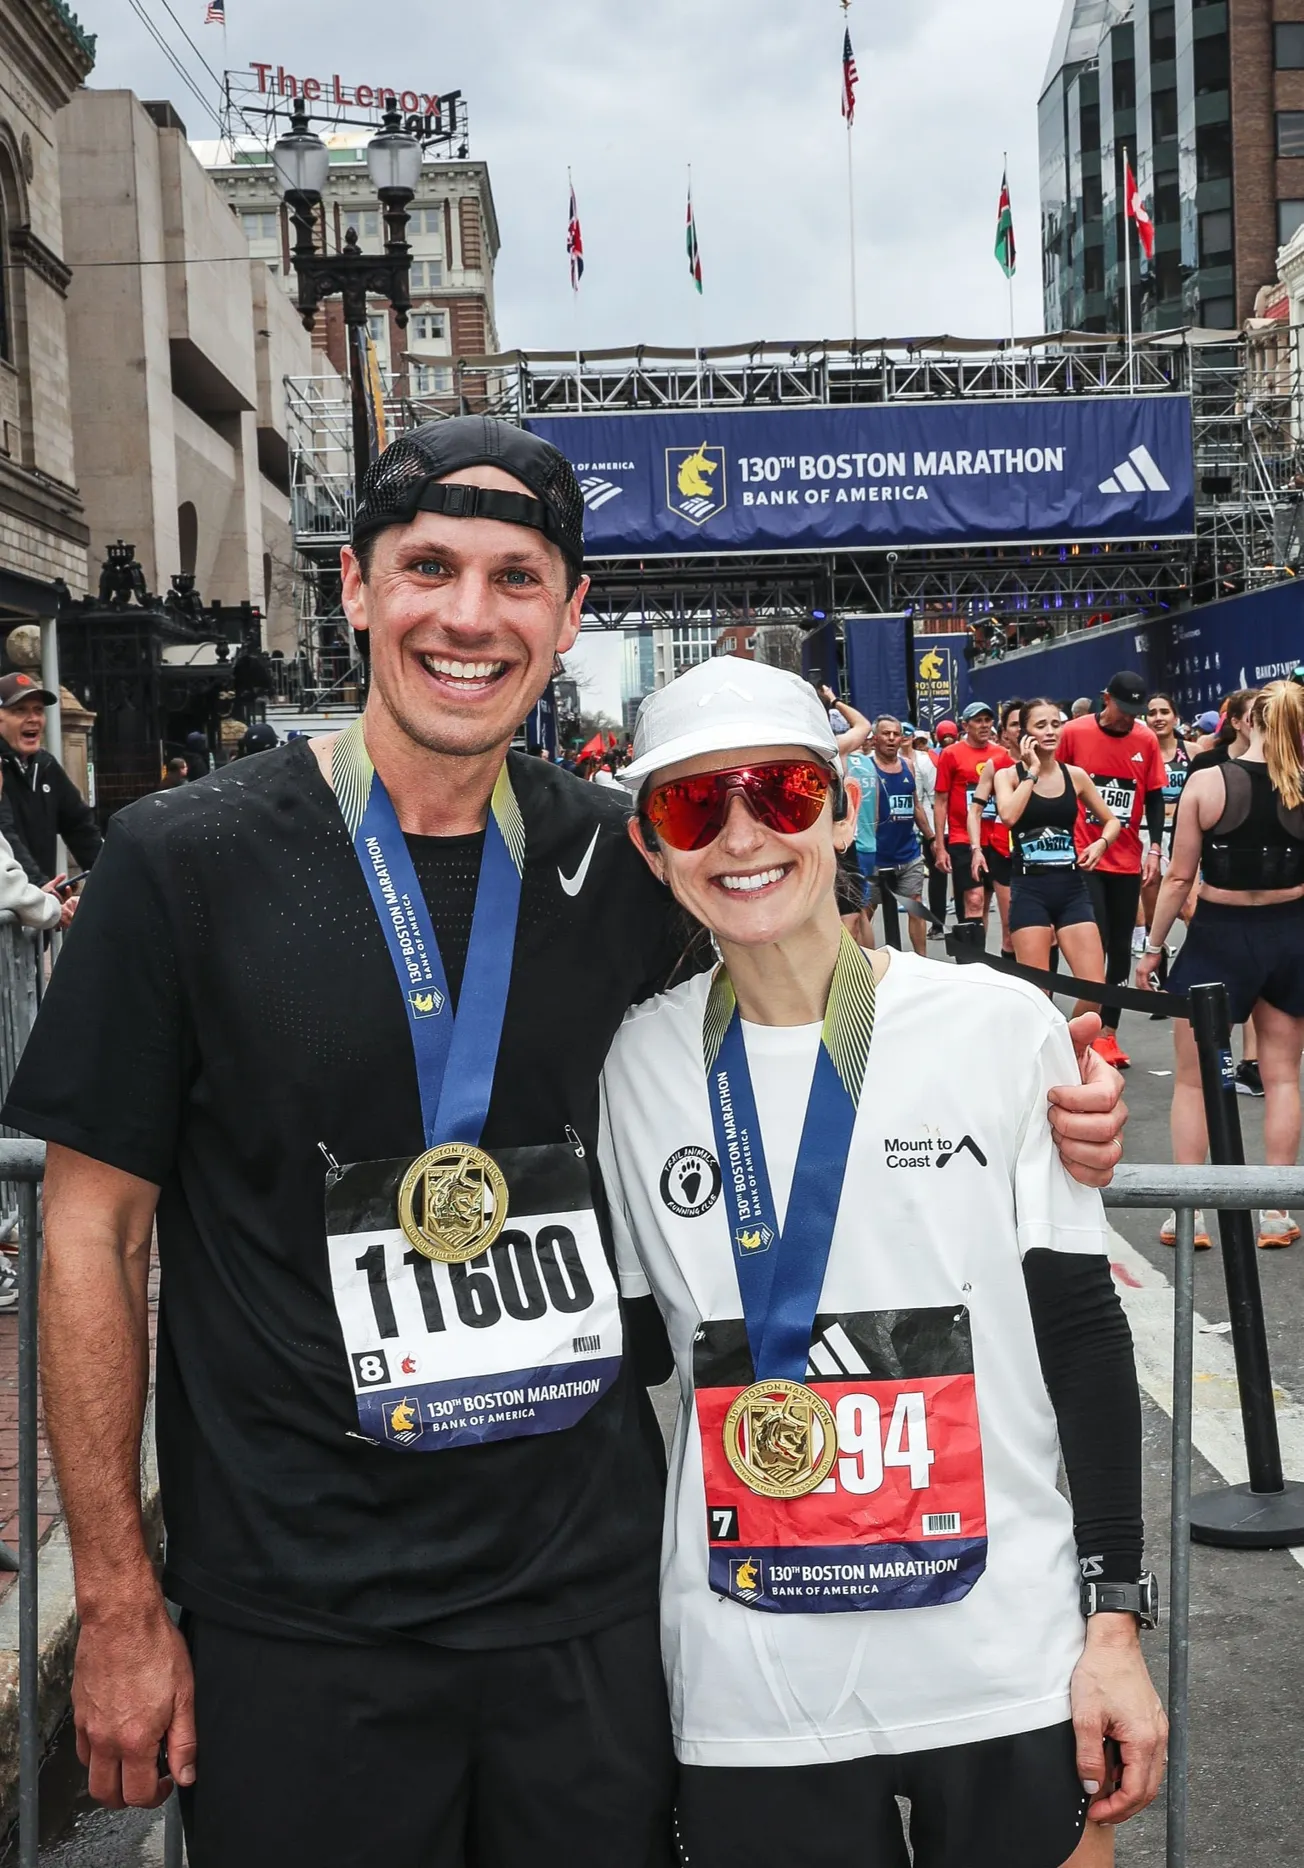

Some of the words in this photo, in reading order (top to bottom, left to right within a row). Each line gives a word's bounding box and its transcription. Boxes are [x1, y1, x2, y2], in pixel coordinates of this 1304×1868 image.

[249, 62, 321, 101] The
[332, 74, 440, 116] Lenox
[577, 463, 590, 471] OF
[591, 462, 635, 471] AMERICA
[738, 457, 795, 482] 130TH
[799, 452, 906, 480] BOSTON
[914, 447, 1063, 476] MARATHON
[743, 490, 799, 505] BANK
[804, 489, 830, 504] OF
[835, 485, 928, 502] AMERICA
[365, 837, 399, 905] MARATHON
[401, 892, 421, 937] AMERICA
[389, 905, 415, 957] BOSTON
[414, 937, 425, 952] OF
[405, 957, 430, 984] 130TH
[418, 953, 432, 980] BANK
[717, 1071, 737, 1140] MARATHON
[420, 1147, 458, 1166] BOSTON
[741, 1128, 755, 1172] AMERICA
[884, 1138, 933, 1152] Mount
[937, 1138, 952, 1150] to
[664, 1151, 683, 1172] TRAIL
[684, 1147, 716, 1167] ANIMALS
[728, 1141, 746, 1193] BOSTON
[886, 1155, 931, 1168] Coast
[748, 1173, 757, 1187] OF
[667, 1201, 700, 1216] RUNNING
[736, 1193, 751, 1221] 130TH
[751, 1188, 762, 1216] BANK
[356, 1225, 594, 1339] 11600
[359, 1355, 384, 1382] 8
[427, 1399, 461, 1418] 130TH
[464, 1392, 524, 1412] BOSTON
[527, 1378, 601, 1402] MARATHON
[743, 1383, 781, 1402] BOSTON
[784, 1384, 831, 1425] MARATHON
[432, 1417, 467, 1432] BANK
[470, 1415, 484, 1426] OF
[488, 1408, 535, 1423] AMERICA
[713, 1512, 733, 1537] 7
[769, 1566, 800, 1581] 130TH
[802, 1565, 864, 1581] BOSTON
[869, 1558, 958, 1579] MARATHON
[772, 1587, 803, 1595] BANK
[806, 1586, 820, 1595] OF
[823, 1585, 879, 1595] AMERICA
